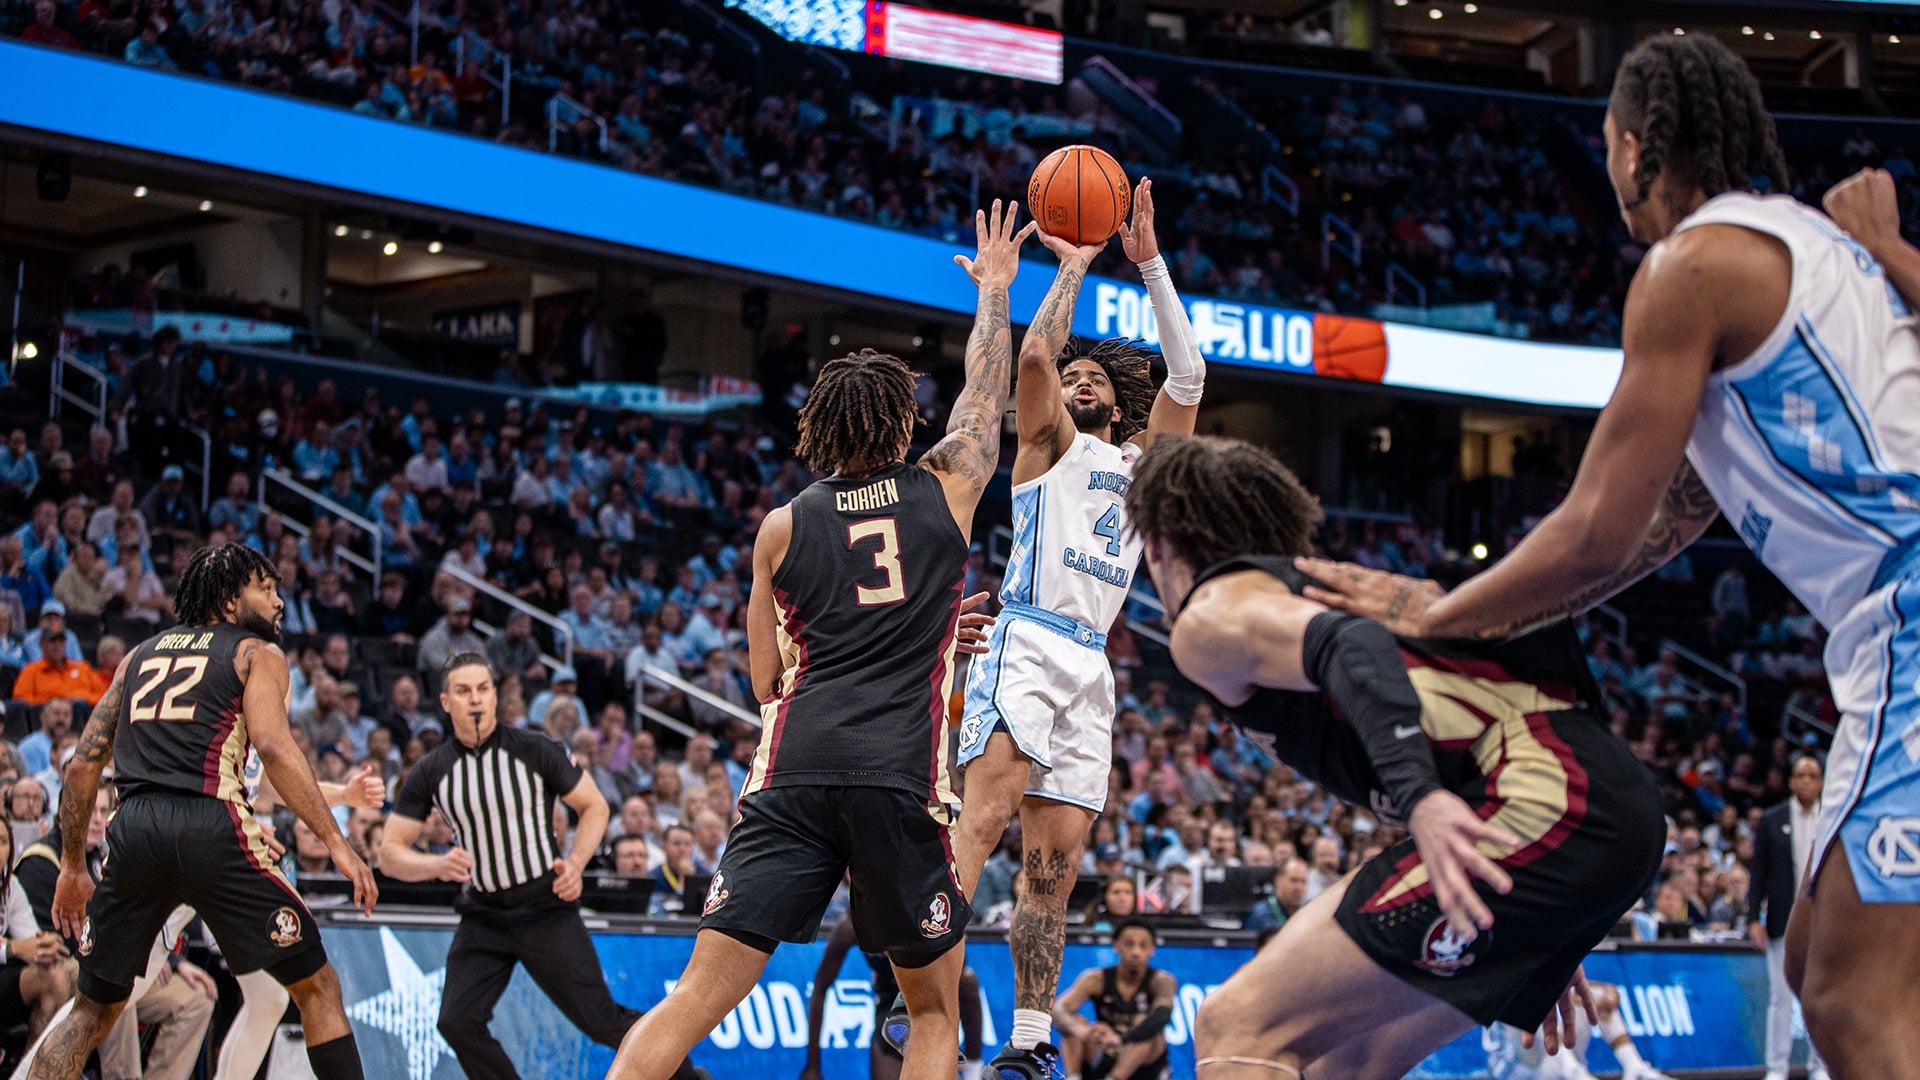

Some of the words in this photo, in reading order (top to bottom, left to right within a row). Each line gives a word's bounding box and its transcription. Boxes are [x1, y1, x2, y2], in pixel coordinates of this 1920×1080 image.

[1096, 282, 1161, 345] FOO
[836, 478, 900, 511] CORHEN
[1088, 471, 1131, 497] NORT
[1093, 503, 1121, 557] 4
[847, 516, 908, 606] 3
[1063, 547, 1129, 588] CAROLIN
[155, 633, 195, 651] GREEN
[191, 632, 214, 650] JR.
[130, 655, 209, 724] 22
[1028, 877, 1057, 896] TMC
[664, 980, 812, 1050] OOD
[1618, 984, 1695, 1037] LION
